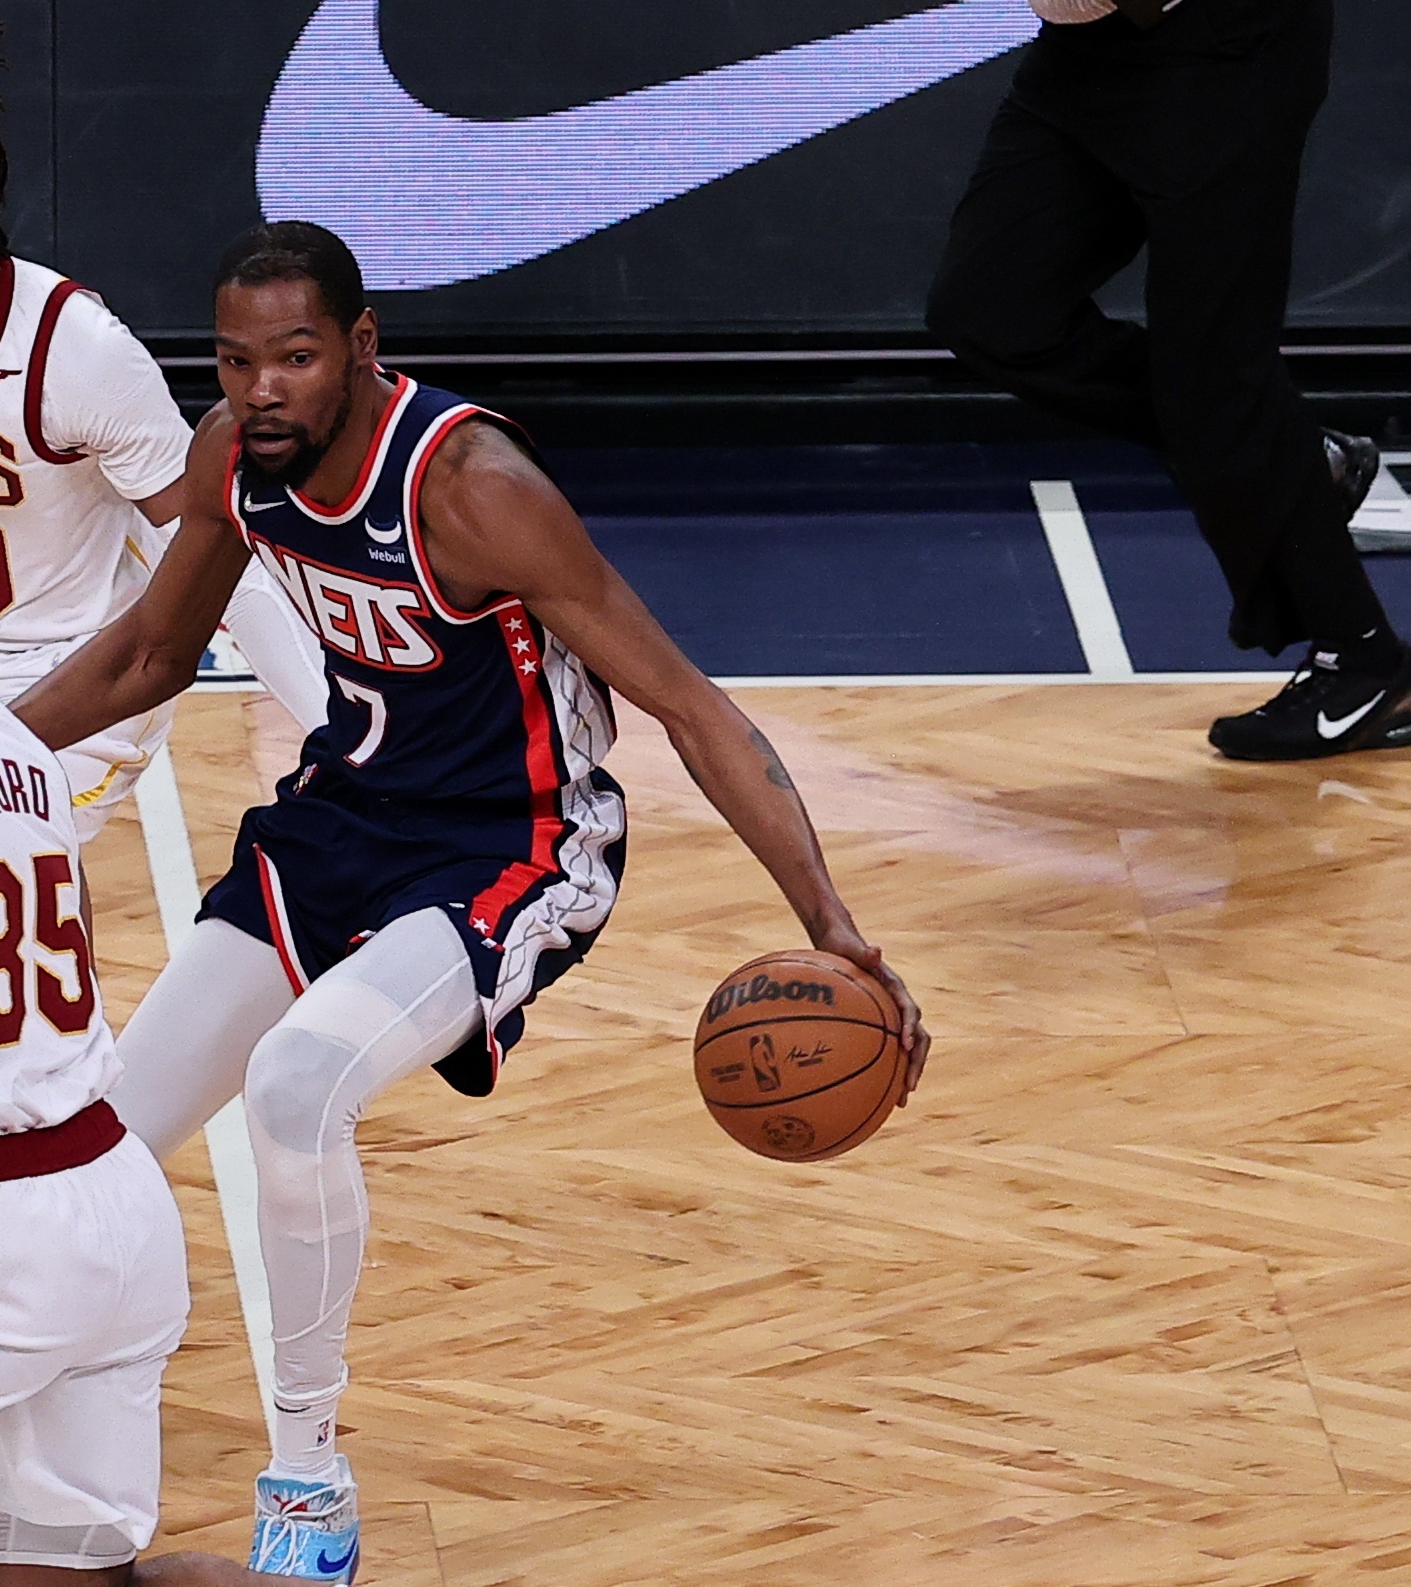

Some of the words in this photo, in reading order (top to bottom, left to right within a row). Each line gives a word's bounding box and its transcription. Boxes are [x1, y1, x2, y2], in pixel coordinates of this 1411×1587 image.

[368, 547, 406, 564] Webull
[250, 532, 443, 672] NETS
[331, 672, 387, 767] 7
[707, 974, 836, 1024] Wilson
